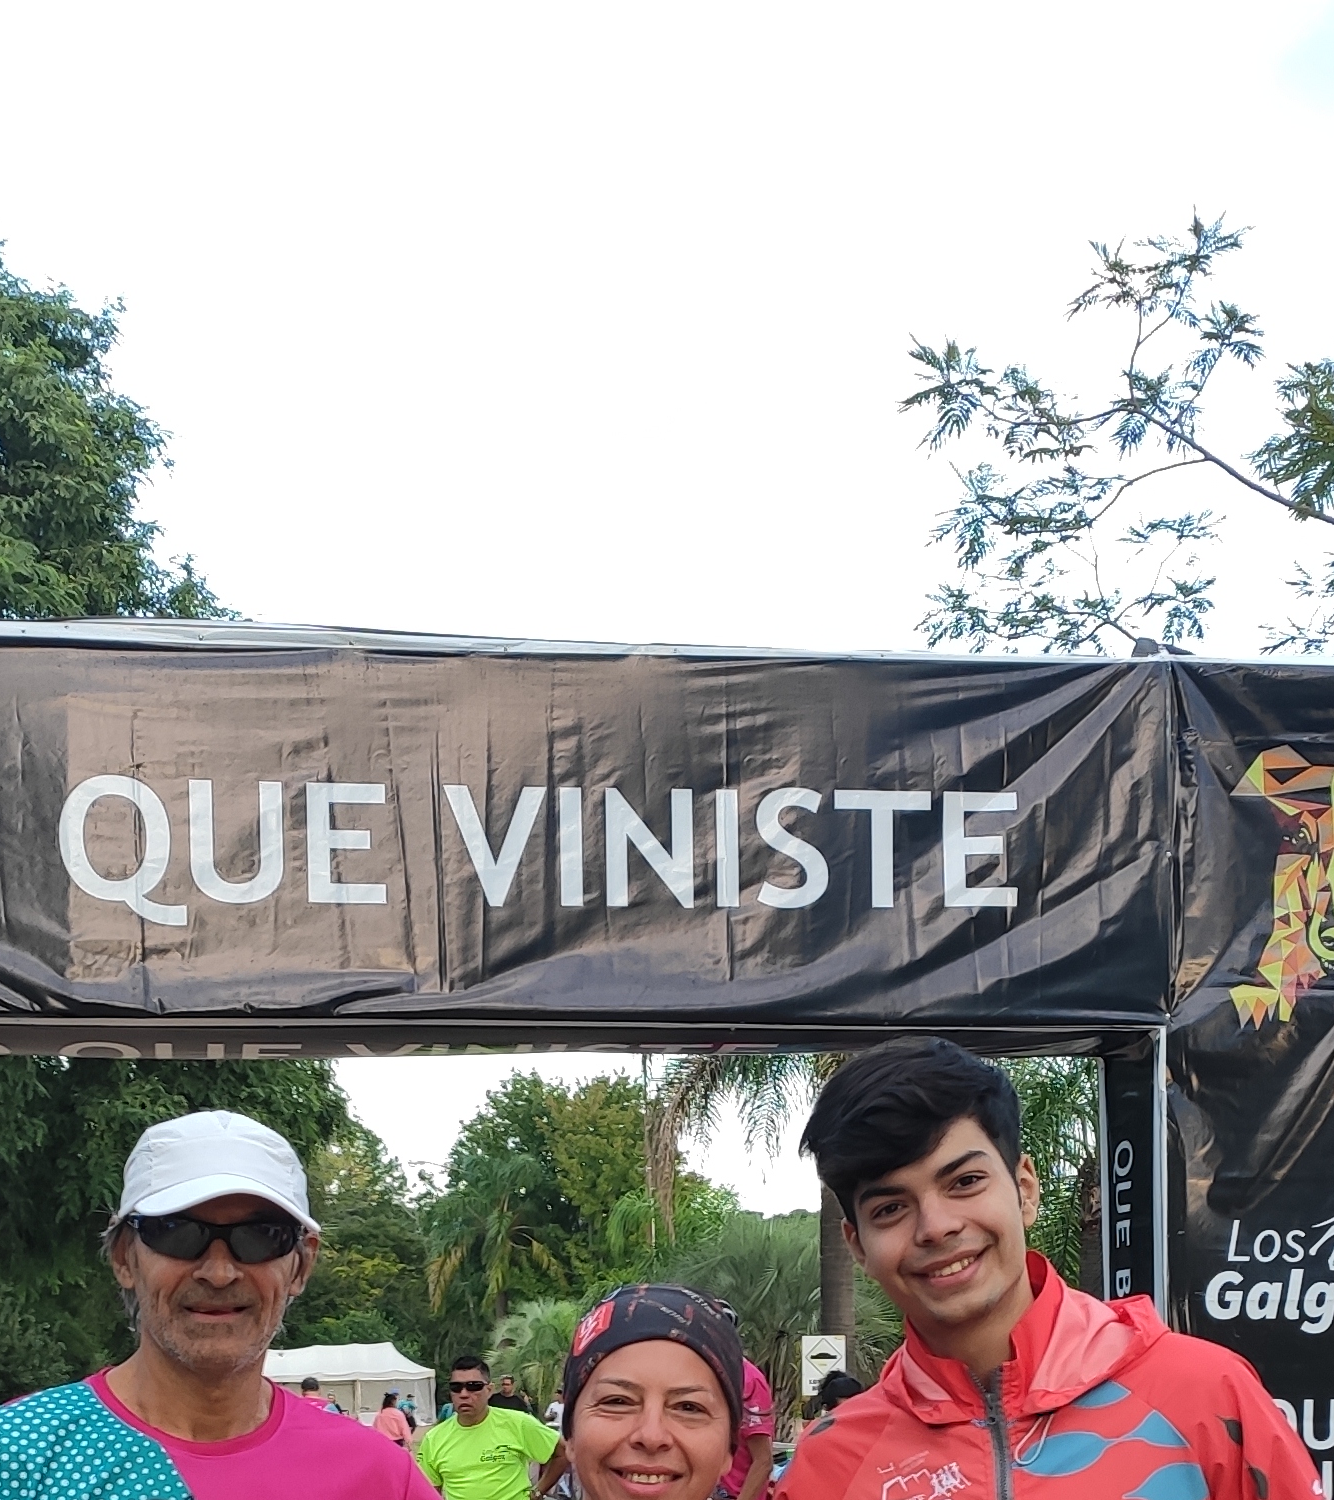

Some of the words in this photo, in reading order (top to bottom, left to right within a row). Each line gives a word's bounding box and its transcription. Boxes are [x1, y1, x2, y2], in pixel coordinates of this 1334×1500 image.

[58, 773, 388, 927] QUE
[443, 784, 1020, 910] VINISTE
[1112, 1139, 1134, 1249] QUE
